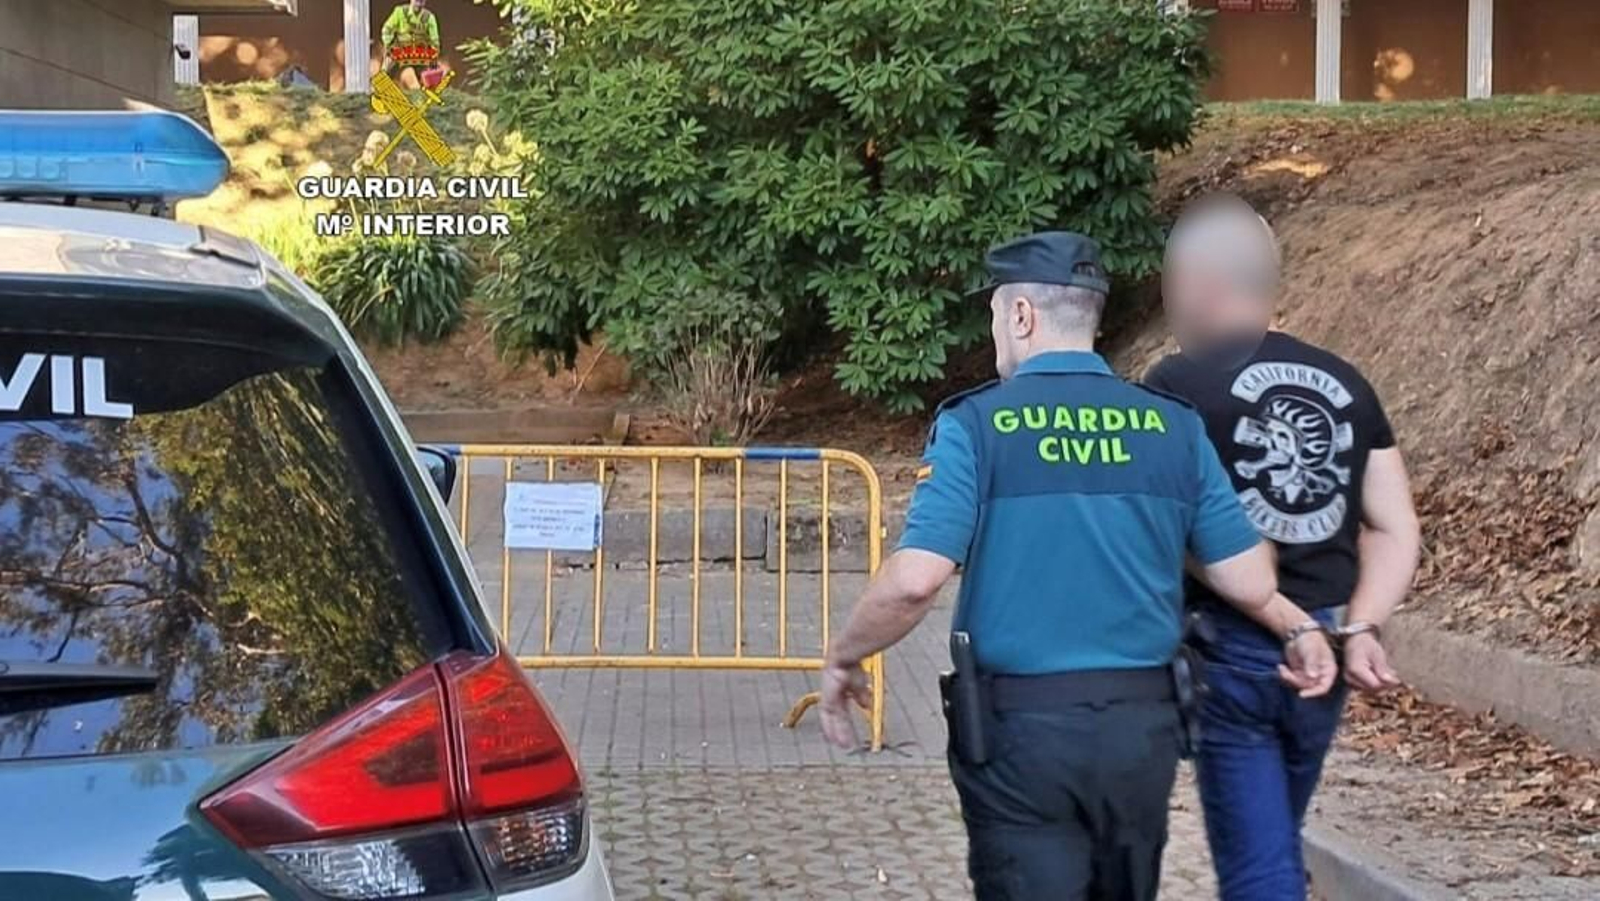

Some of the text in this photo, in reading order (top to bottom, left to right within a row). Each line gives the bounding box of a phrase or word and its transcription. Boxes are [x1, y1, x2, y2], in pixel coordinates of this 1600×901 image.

[1241, 366, 1341, 399] CALIFORNIA
[993, 406, 1166, 433] GUARDIA
[1038, 436, 1131, 465] CIVIL
